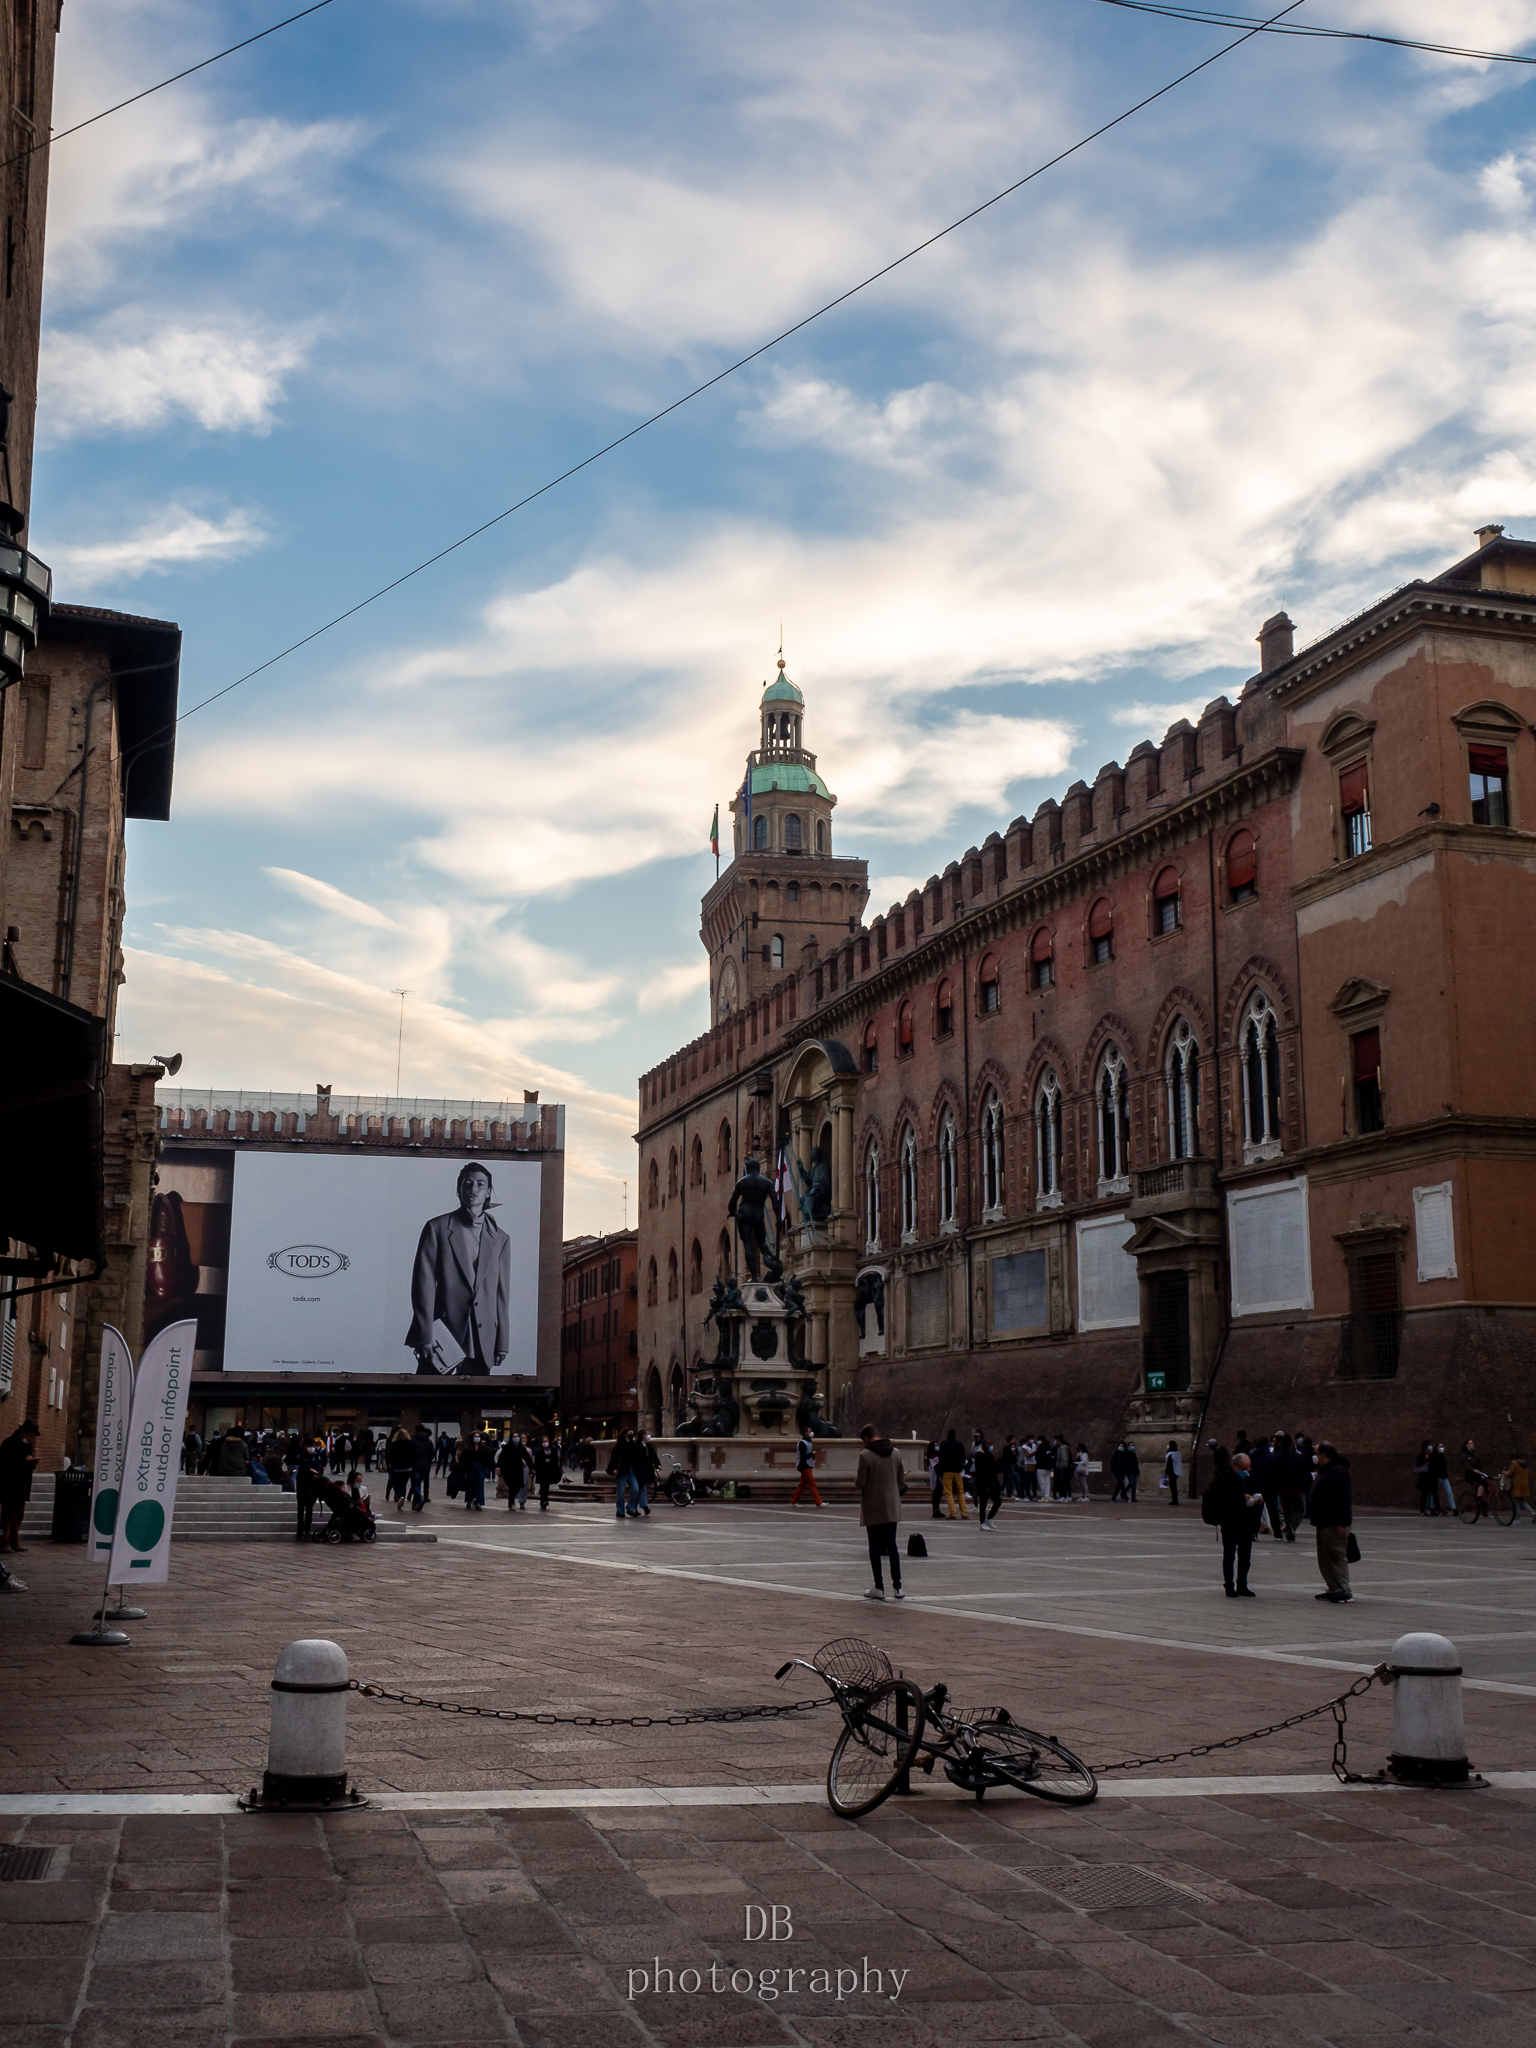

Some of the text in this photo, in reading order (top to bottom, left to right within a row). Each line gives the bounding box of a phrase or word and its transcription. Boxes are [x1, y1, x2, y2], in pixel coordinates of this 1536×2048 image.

[287, 1254, 330, 1268] TOD'S
[156, 1347, 182, 1493] outdoor infopoint
[137, 1421, 154, 1492] eXtraBO
